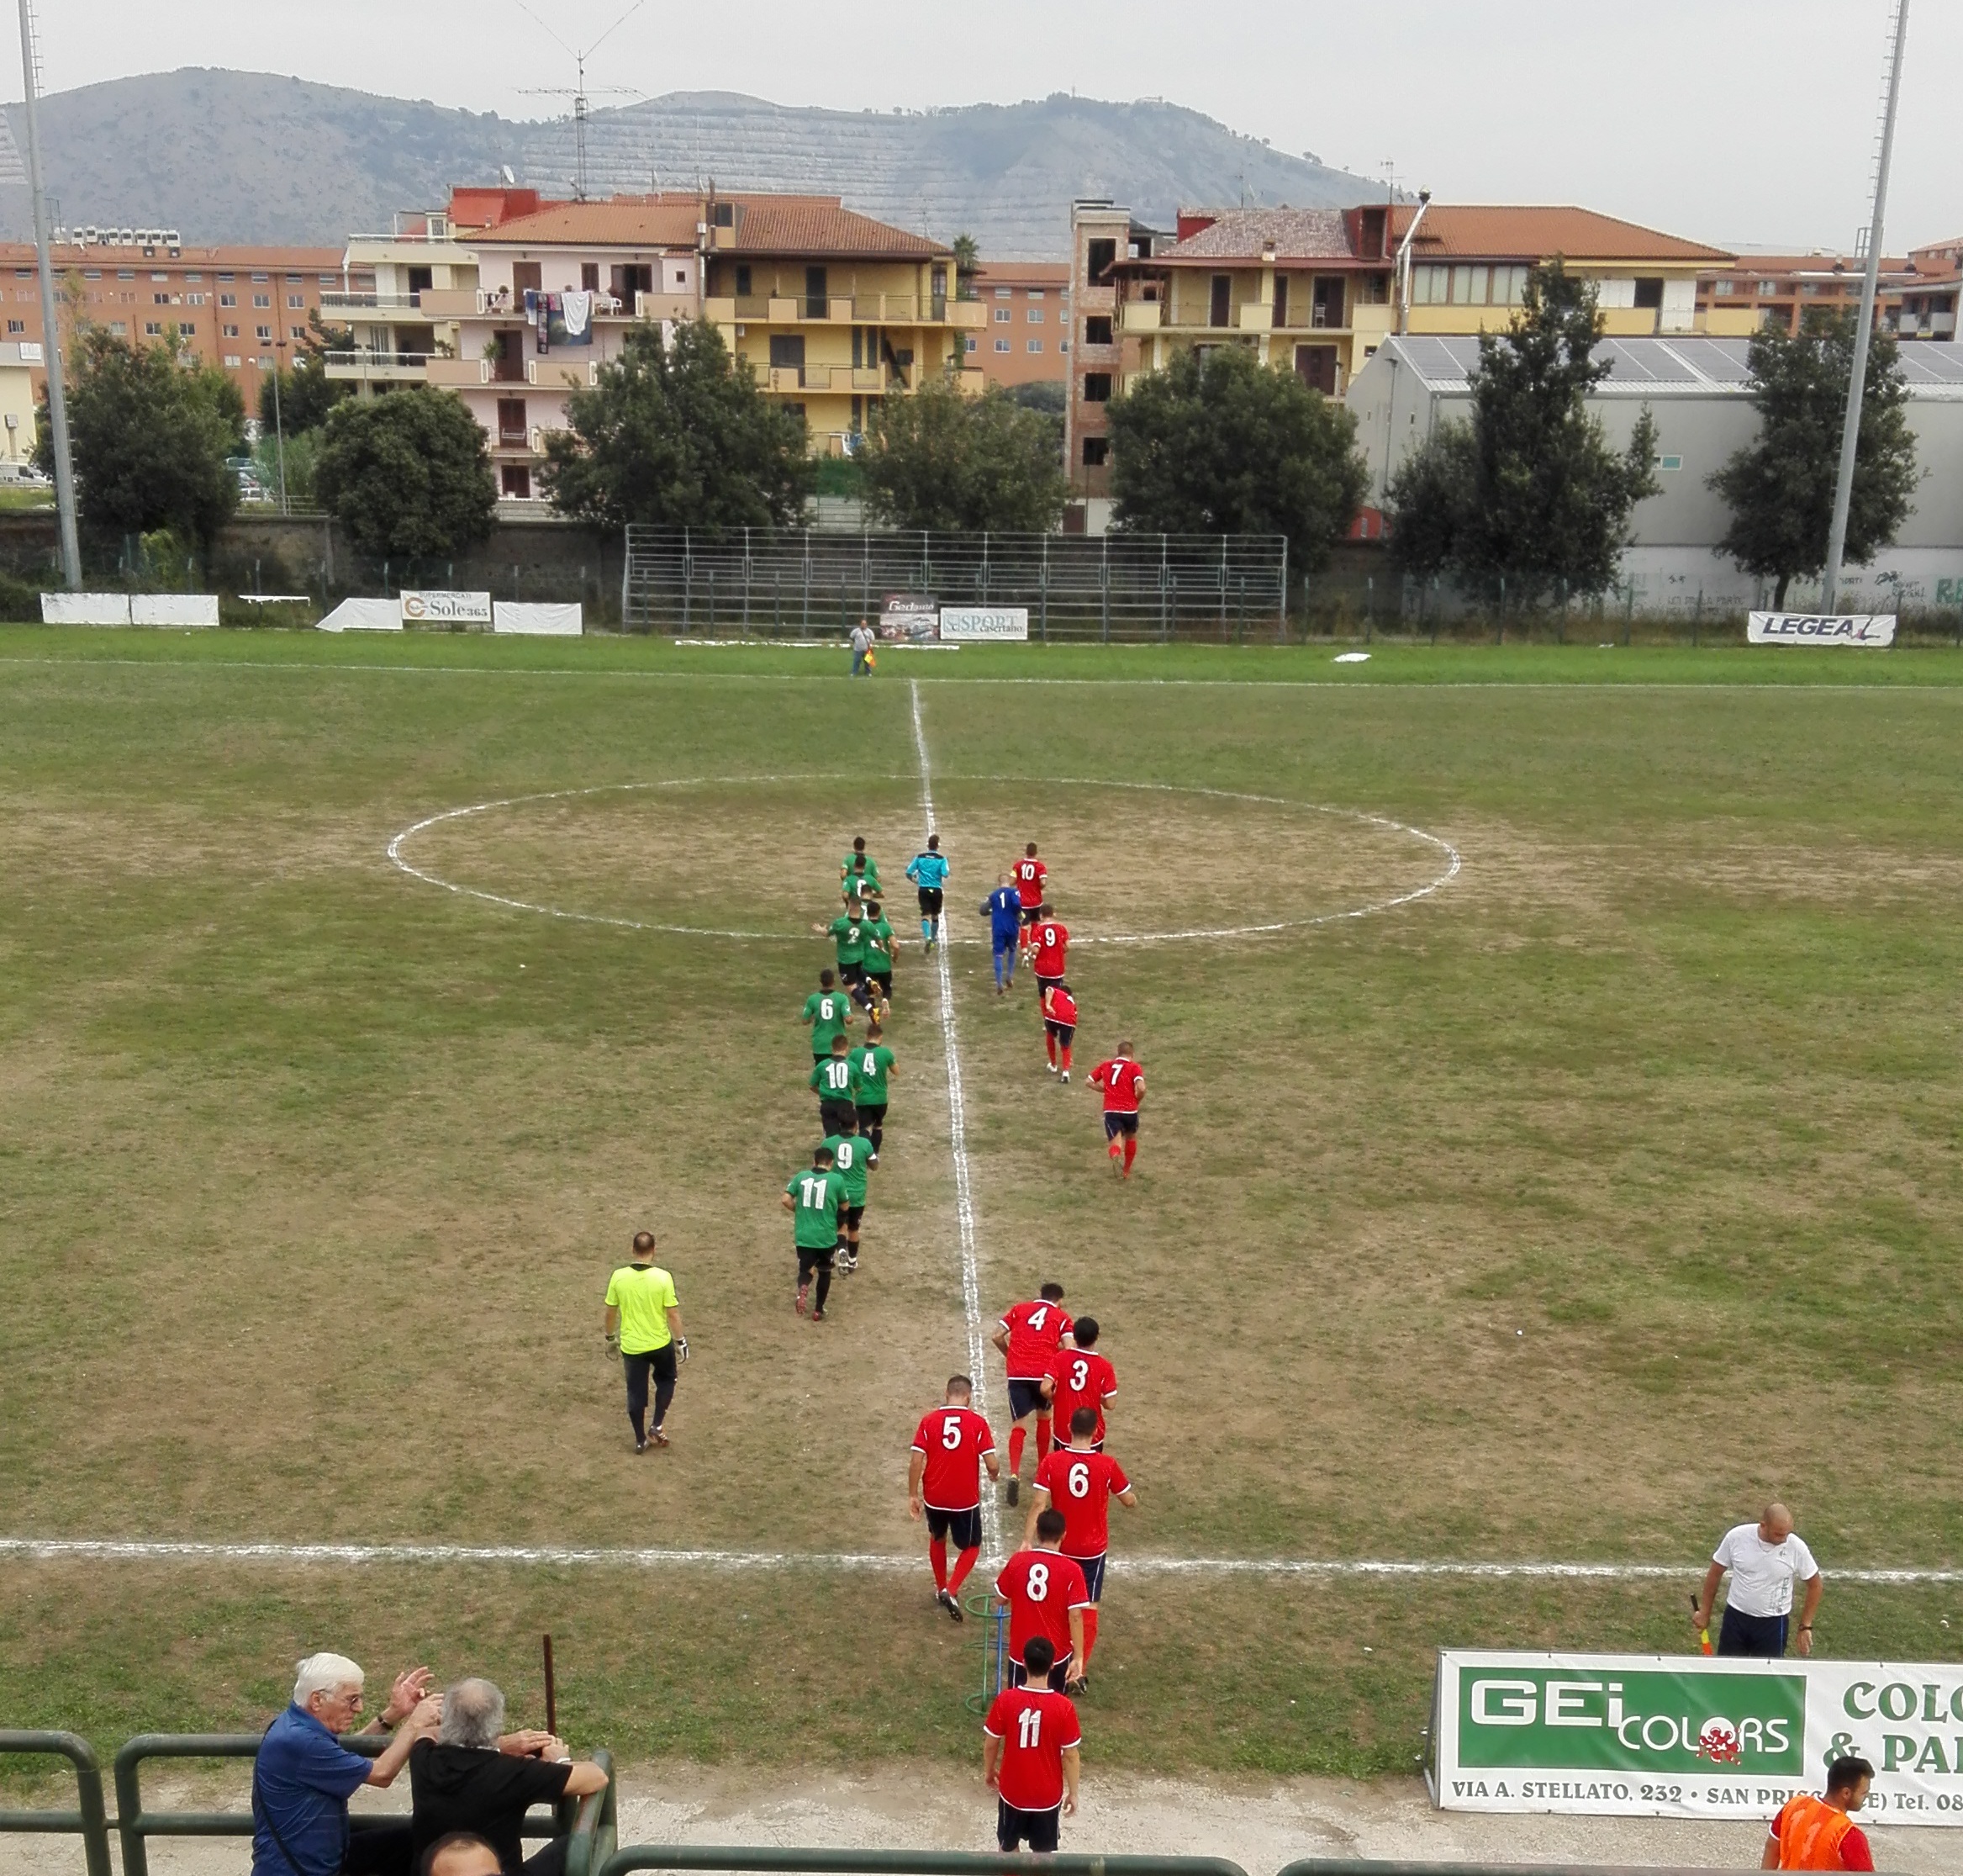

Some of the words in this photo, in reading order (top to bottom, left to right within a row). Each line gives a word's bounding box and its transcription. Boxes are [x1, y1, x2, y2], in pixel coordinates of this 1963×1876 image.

[430, 600, 465, 616] Sole
[467, 607, 488, 616] 365
[961, 615, 1017, 631] SPORT
[1762, 617, 1854, 636] LEGEA
[1021, 863, 1035, 880] 10
[1000, 892, 1005, 908] 1
[1045, 927, 1056, 947] 9
[821, 998, 834, 1020] 6
[825, 1062, 848, 1089] 10
[863, 1052, 877, 1076] 4
[1111, 1063, 1124, 1086] 7
[837, 1143, 852, 1170] 9
[800, 1177, 827, 1210] 11
[1027, 1307, 1047, 1331] 4
[1069, 1359, 1089, 1392] 3
[942, 1416, 962, 1450] 5
[1069, 1462, 1089, 1498] 6
[1026, 1562, 1049, 1602] 8
[1017, 1707, 1042, 1749] 11
[1617, 1715, 1790, 1754] COLORS
[1823, 1731, 1860, 1771] &
[1881, 1734, 1963, 1774] PA
[1452, 1781, 1490, 1798] VIA
[1495, 1782, 1515, 1799] A.
[1522, 1782, 1633, 1801] STELLATO,
[1640, 1784, 1682, 1803] 232
[1707, 1788, 1749, 1805] SAN
[1894, 1794, 1929, 1810] Tel.
